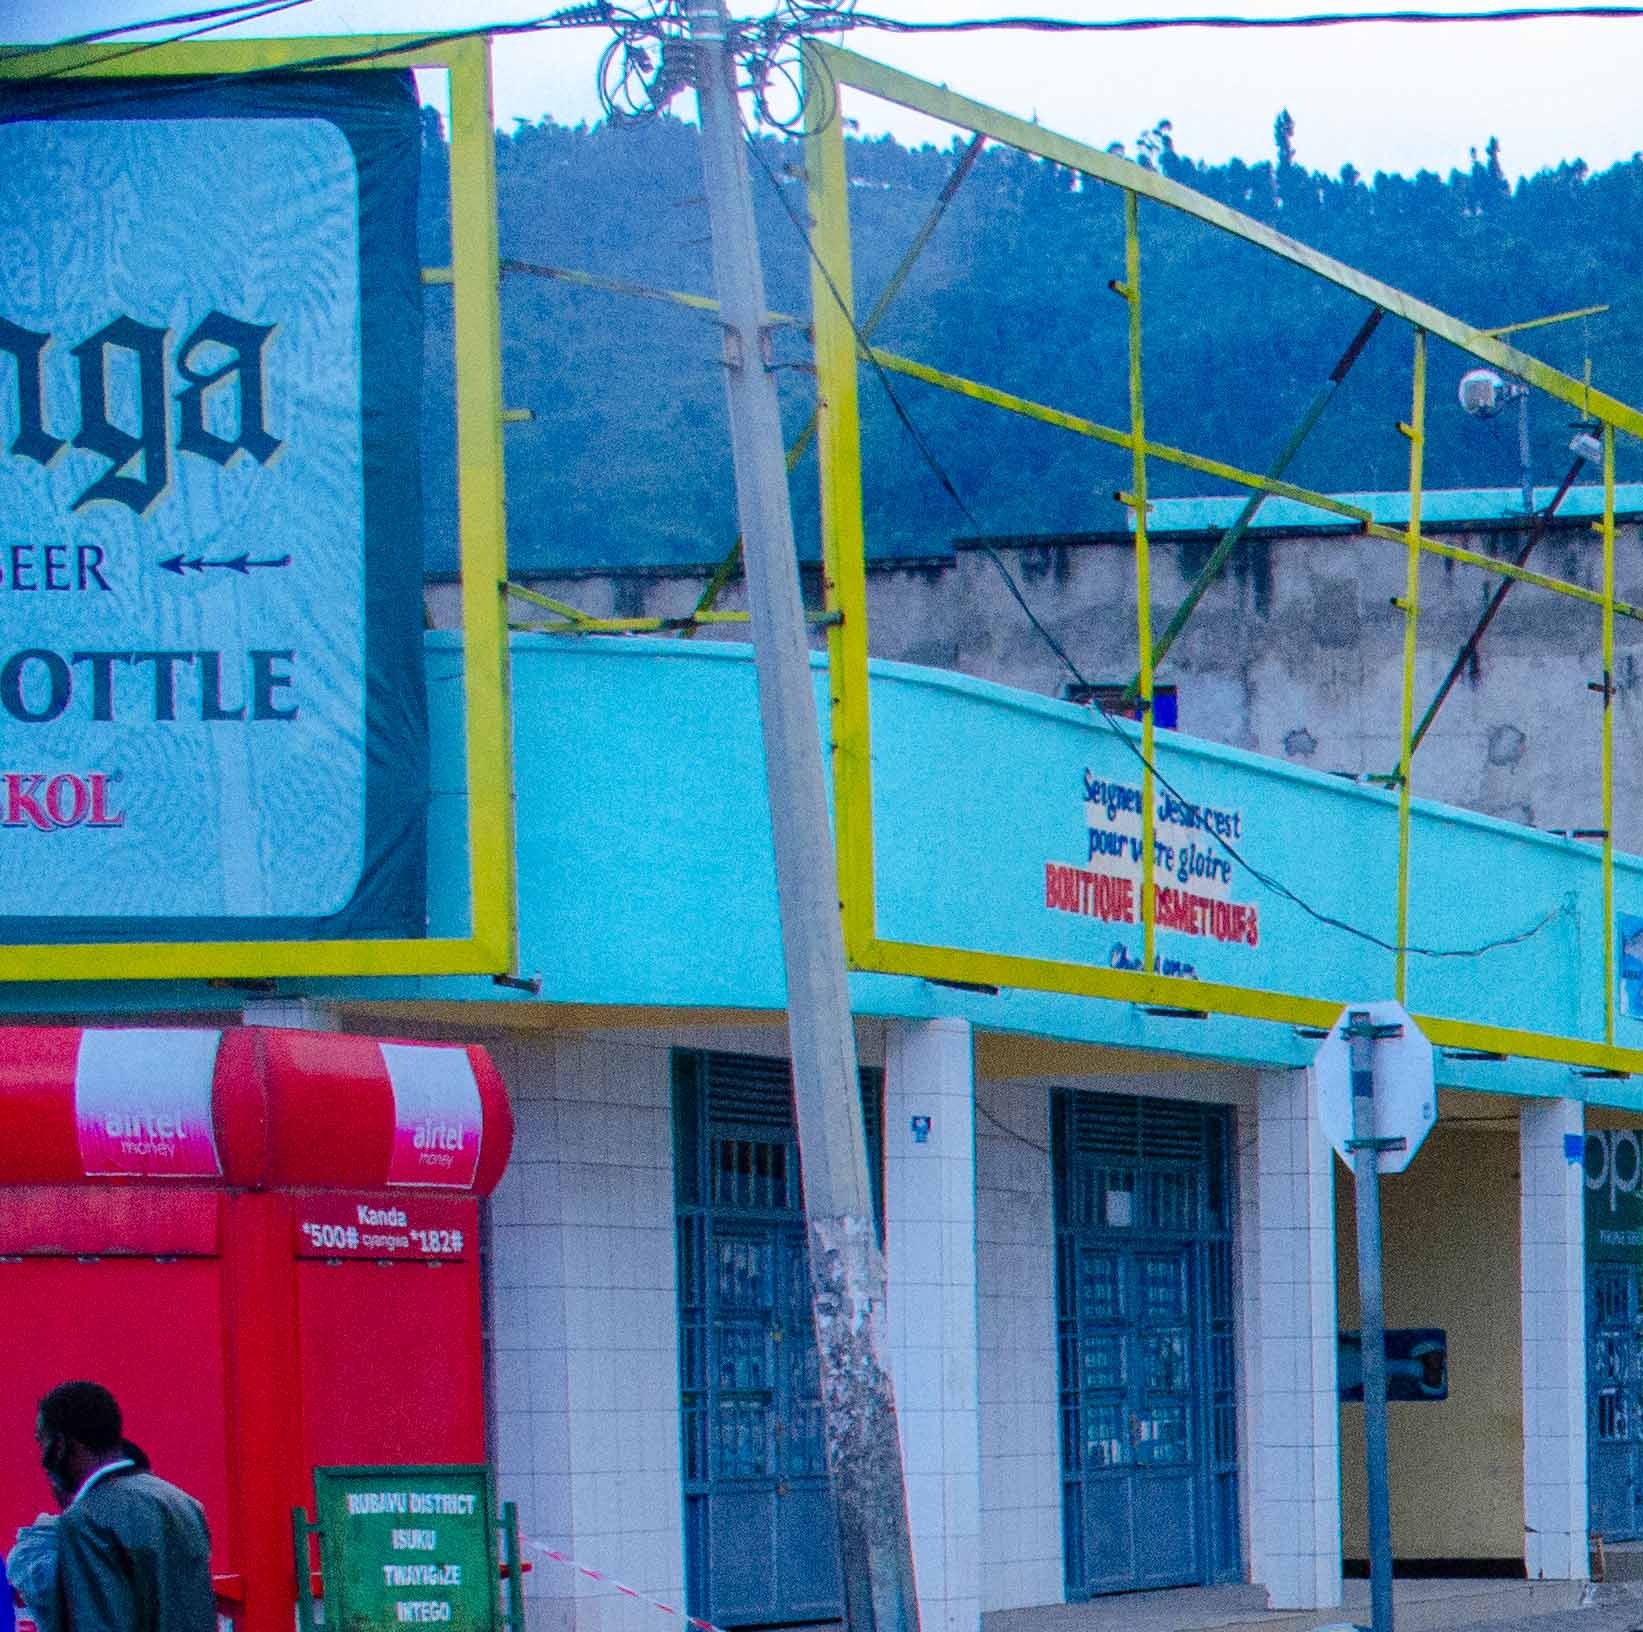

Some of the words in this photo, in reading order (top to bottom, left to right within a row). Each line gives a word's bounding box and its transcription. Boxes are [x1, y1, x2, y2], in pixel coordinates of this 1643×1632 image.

[0, 544, 112, 591] EER
[0, 648, 299, 722] OTTLE
[0, 772, 124, 832] KOL
[1045, 863, 1134, 924] BOUTIQUE
[105, 1108, 187, 1138] airtel
[413, 1118, 464, 1150] airtel
[357, 1204, 408, 1228] Kanda
[408, 1492, 477, 1515] DISTRICT
